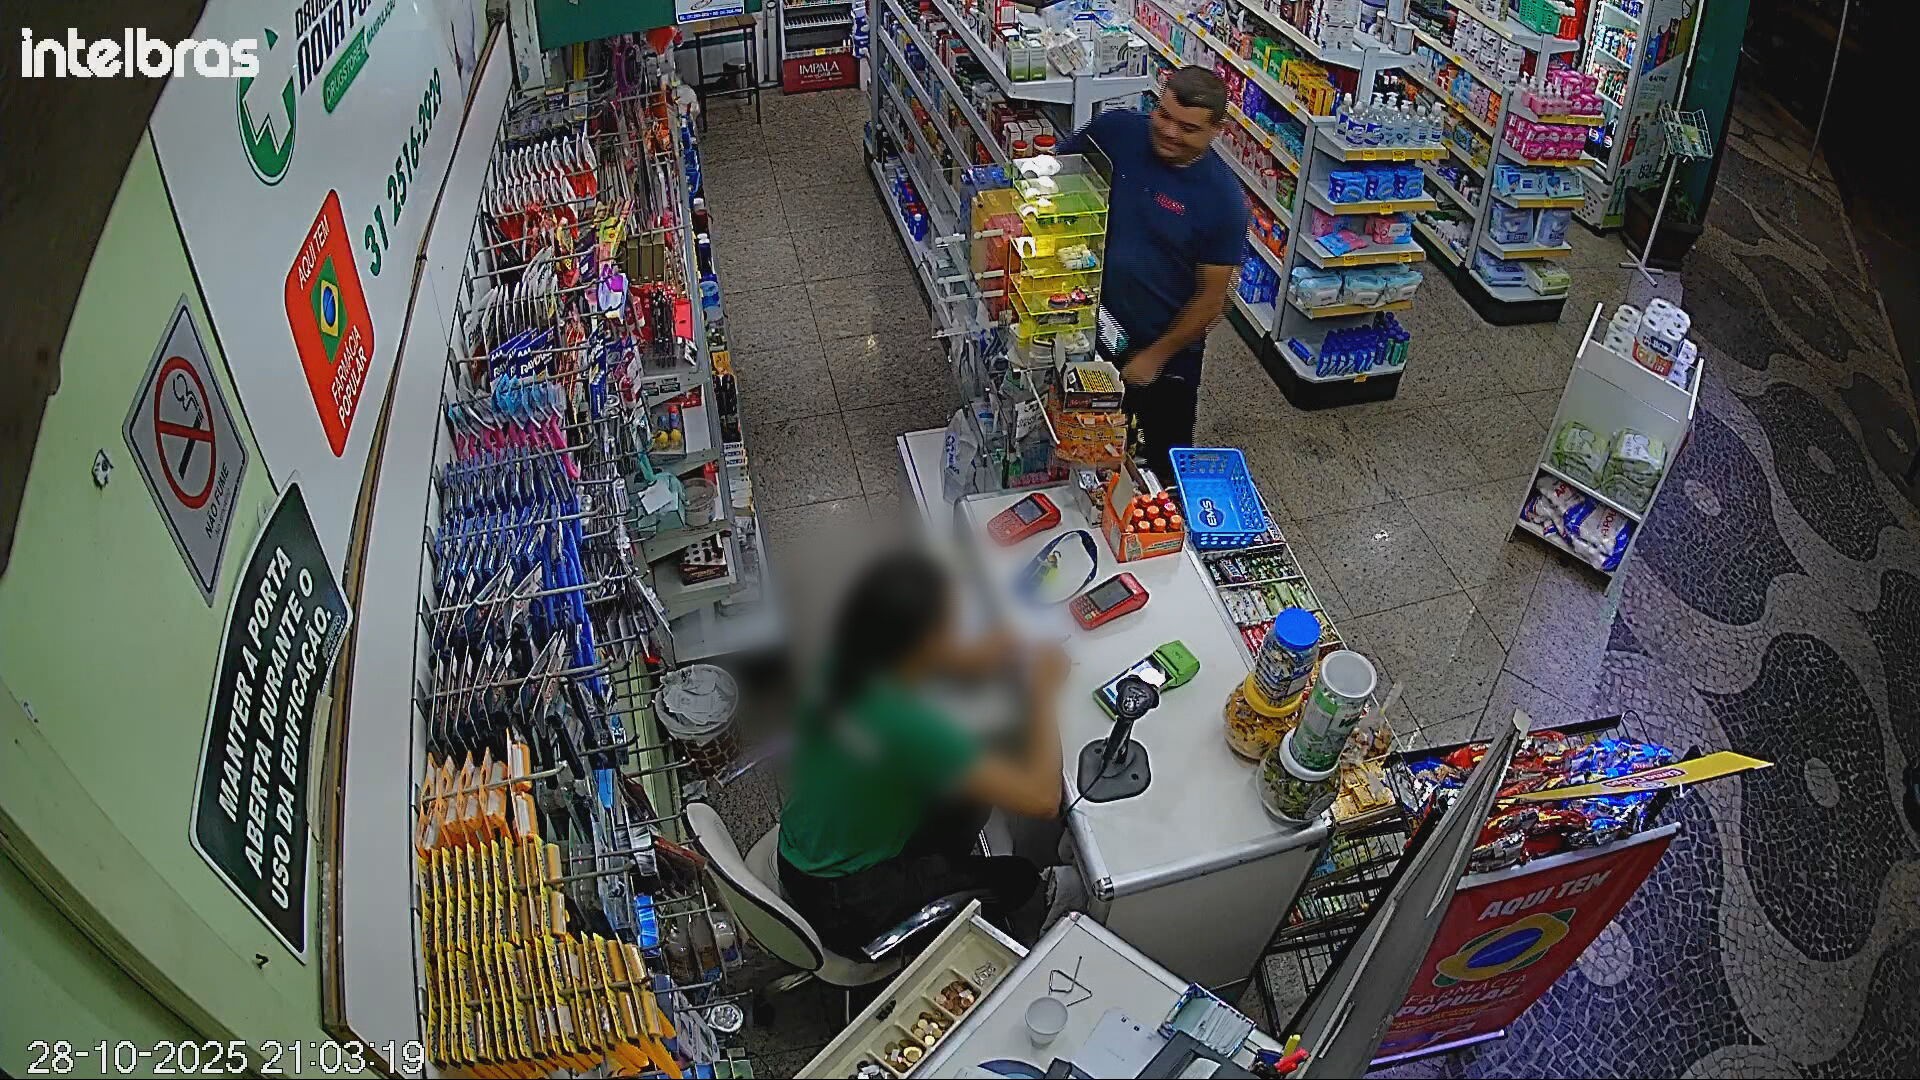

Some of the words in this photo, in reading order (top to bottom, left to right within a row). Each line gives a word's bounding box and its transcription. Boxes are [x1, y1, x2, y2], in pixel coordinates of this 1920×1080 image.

[297, 0, 345, 95] NOVA
[349, 0, 373, 29] PO
[326, 44, 361, 105] DRUGSTORE
[799, 61, 839, 75] IMPALA
[365, 205, 388, 277] 31
[387, 67, 442, 227] 2516-2929
[297, 245, 316, 291] AQUI
[313, 214, 330, 253] TEM
[331, 325, 362, 405] FARMÁCIA
[338, 347, 368, 429] POPULAR
[204, 502, 218, 540] NÃO
[214, 462, 230, 505] FUME
[1202, 500, 1218, 527] EMS
[248, 546, 292, 650] PORTA
[242, 646, 259, 681] A
[281, 606, 333, 786] EDIFICAÇÃO.
[219, 680, 252, 822] MANTER
[245, 738, 273, 880] ABERTA
[259, 591, 304, 741] DURANTE
[299, 567, 314, 598] O
[276, 784, 295, 836] DA
[272, 833, 293, 910] USO
[1477, 886, 1555, 922] AQUI
[1555, 869, 1613, 899] TEM
